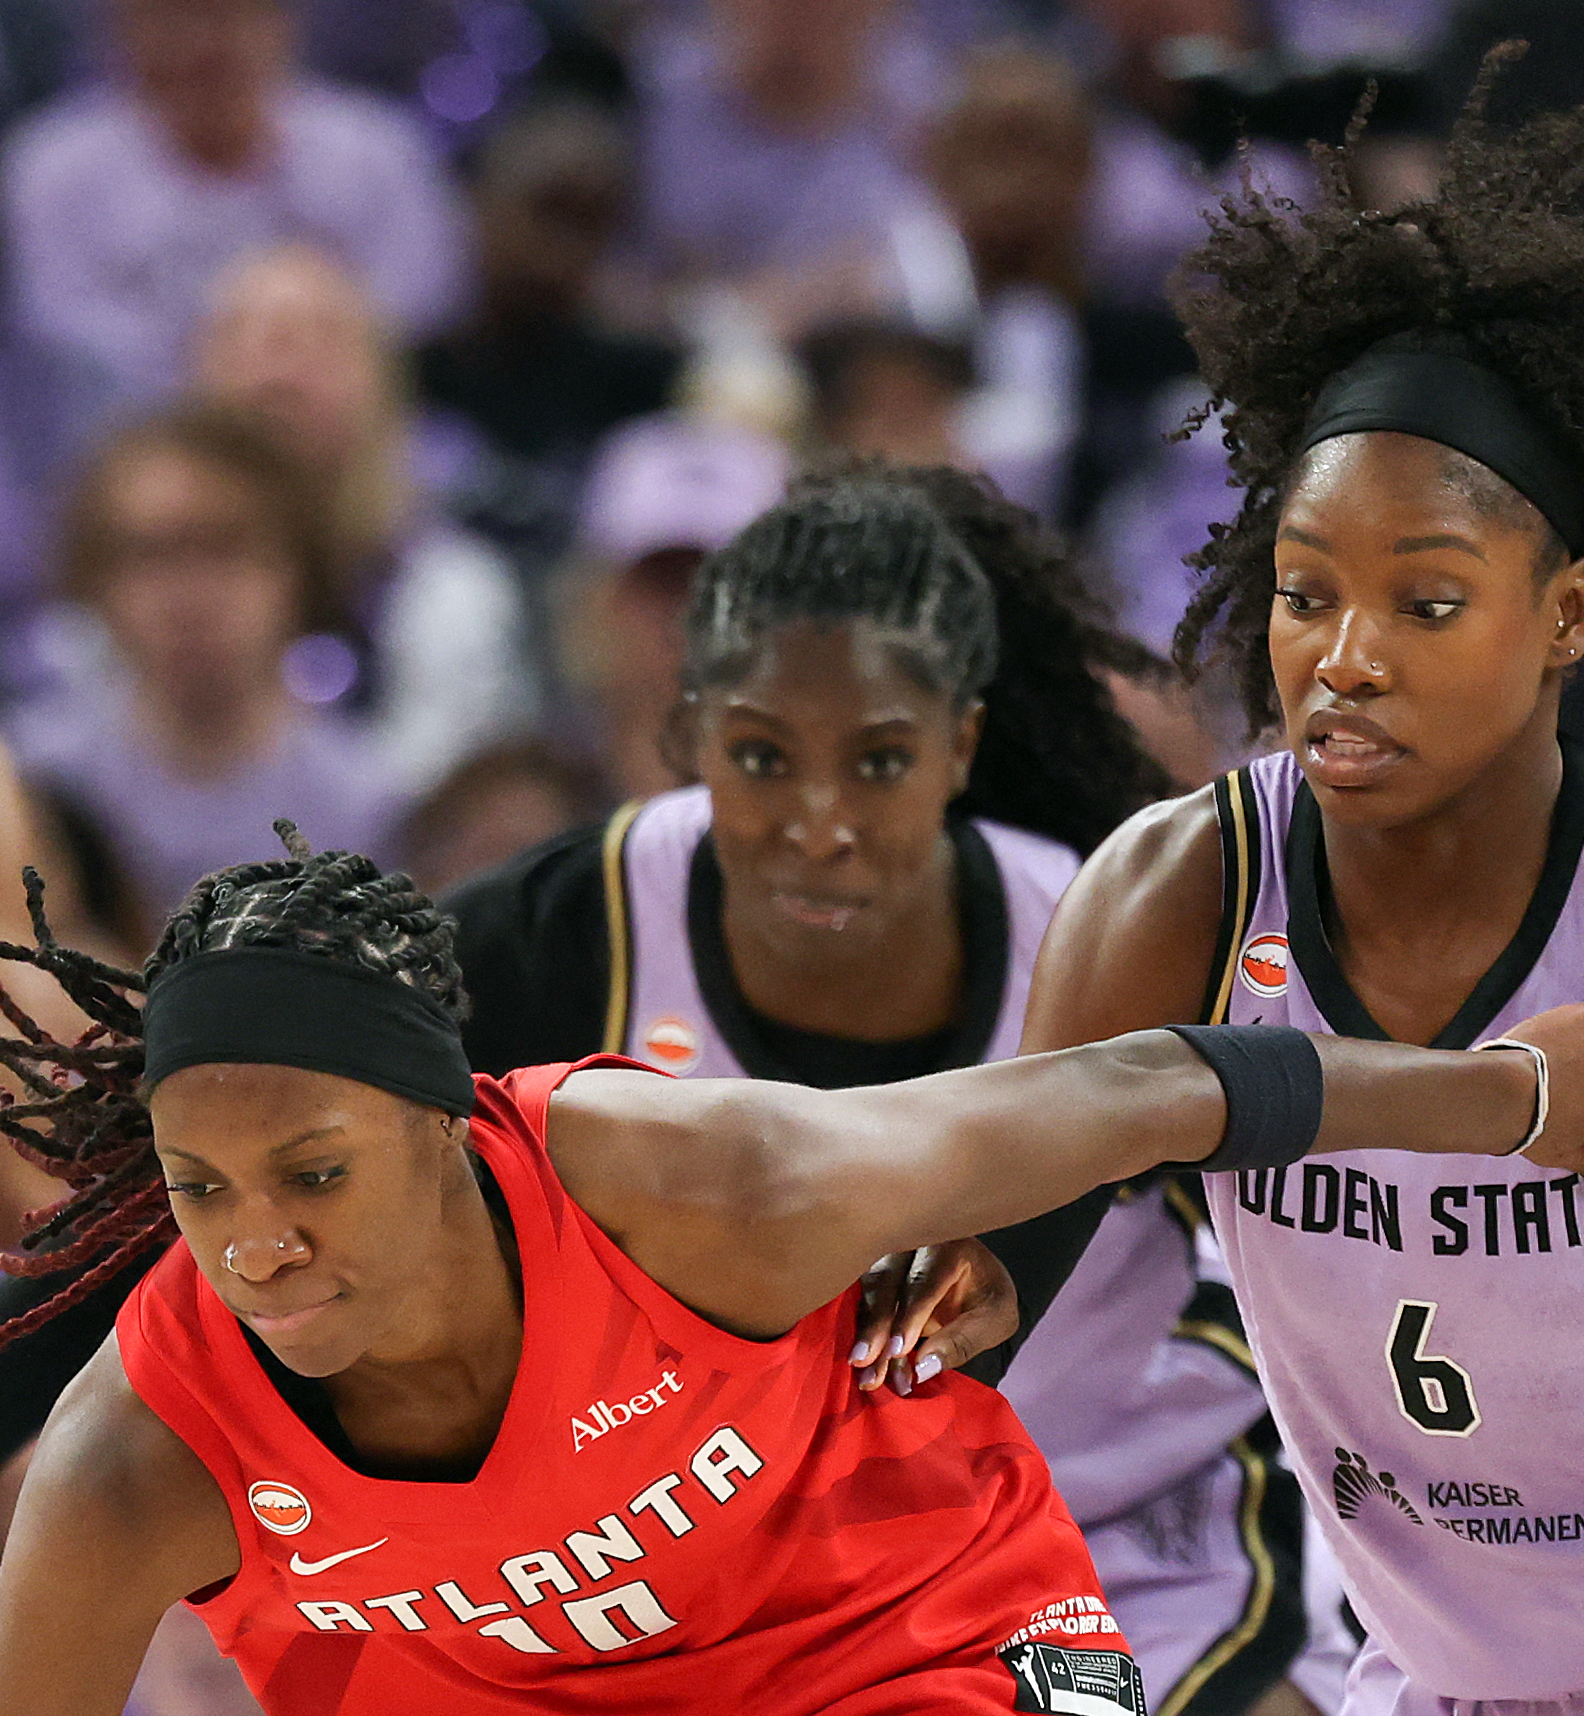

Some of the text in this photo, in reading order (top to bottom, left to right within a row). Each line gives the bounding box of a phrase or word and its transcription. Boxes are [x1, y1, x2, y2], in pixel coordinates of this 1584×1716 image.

[1233, 1160, 1404, 1253] OLDEN
[568, 1369, 684, 1453] Albert
[1385, 1299, 1482, 1438] 6
[296, 1423, 765, 1632] ATLANTA
[1427, 1482, 1524, 1508] KAISER
